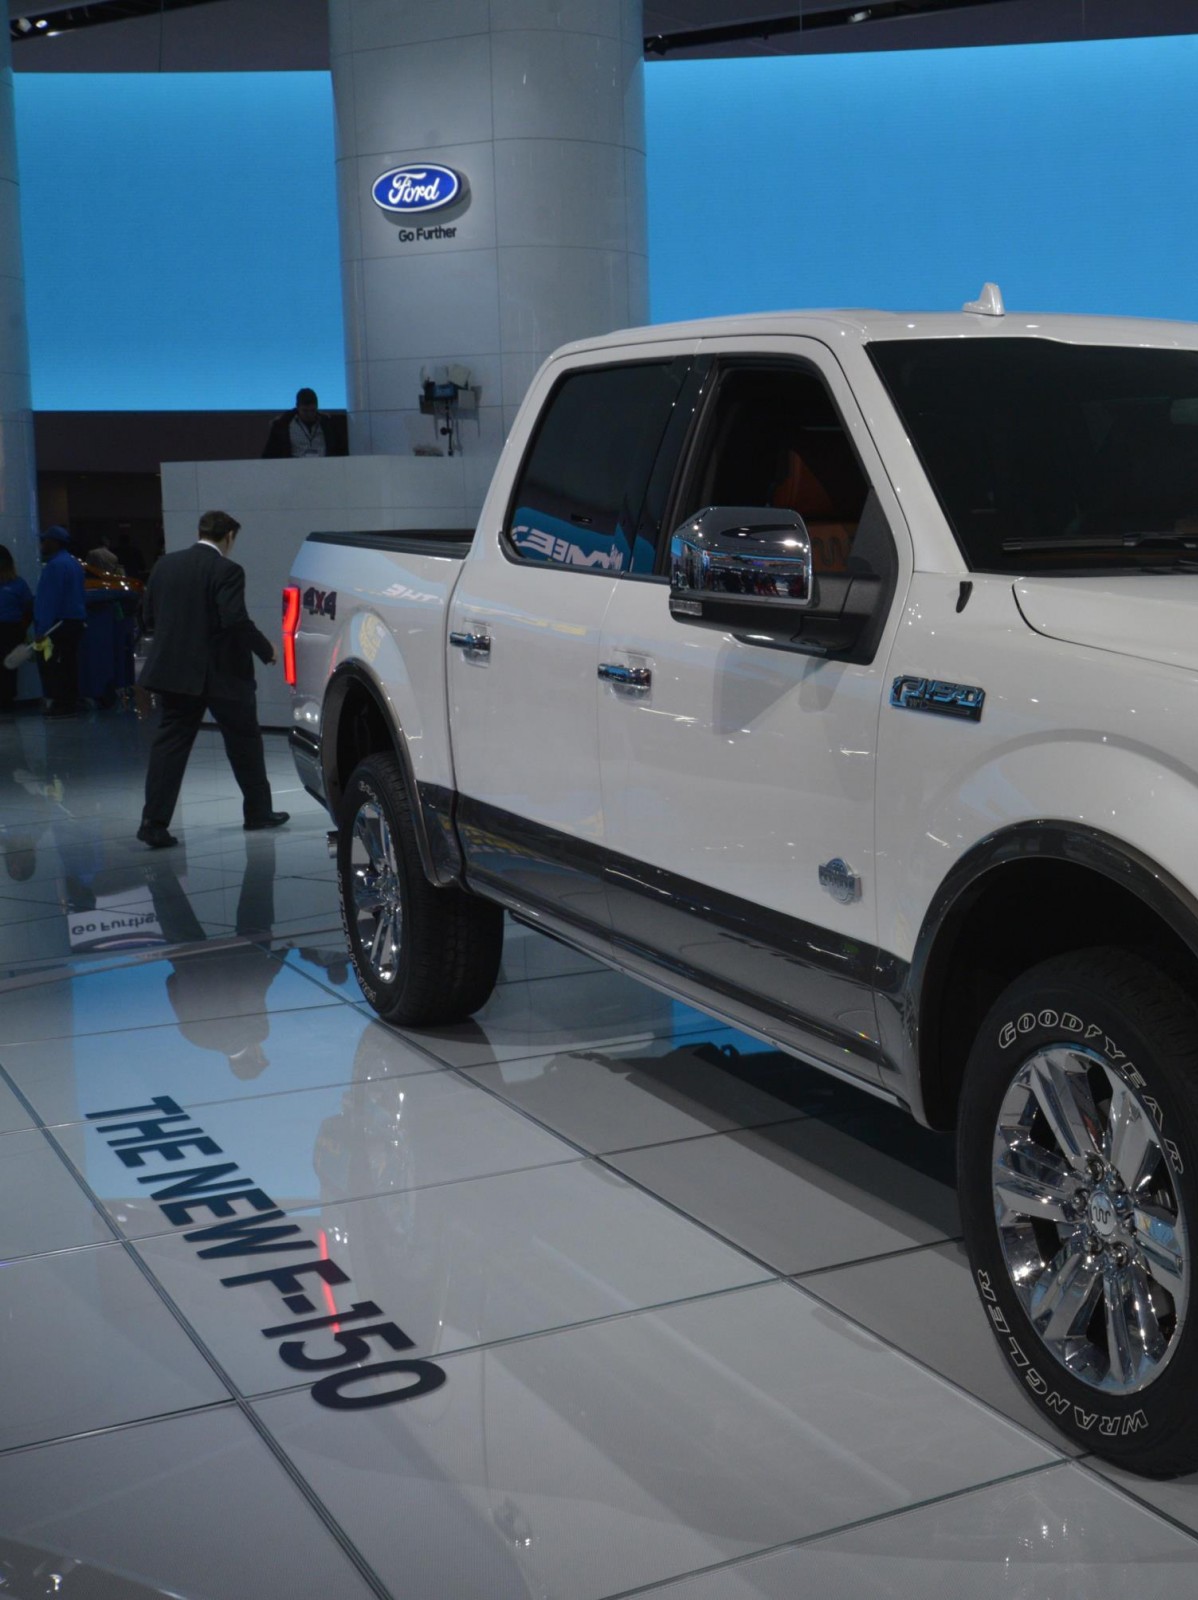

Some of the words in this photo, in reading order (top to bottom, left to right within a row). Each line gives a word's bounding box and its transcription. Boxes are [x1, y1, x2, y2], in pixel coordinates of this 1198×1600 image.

[388, 172, 440, 204] Ford
[398, 229, 415, 242] Go
[416, 226, 457, 240] Further
[84, 1095, 224, 1169] THE
[998, 1009, 1184, 1175] GOODYEAR
[136, 1161, 318, 1260] NEW
[219, 1258, 447, 1411] F-150
[976, 1268, 1150, 1436] WRANGLER
